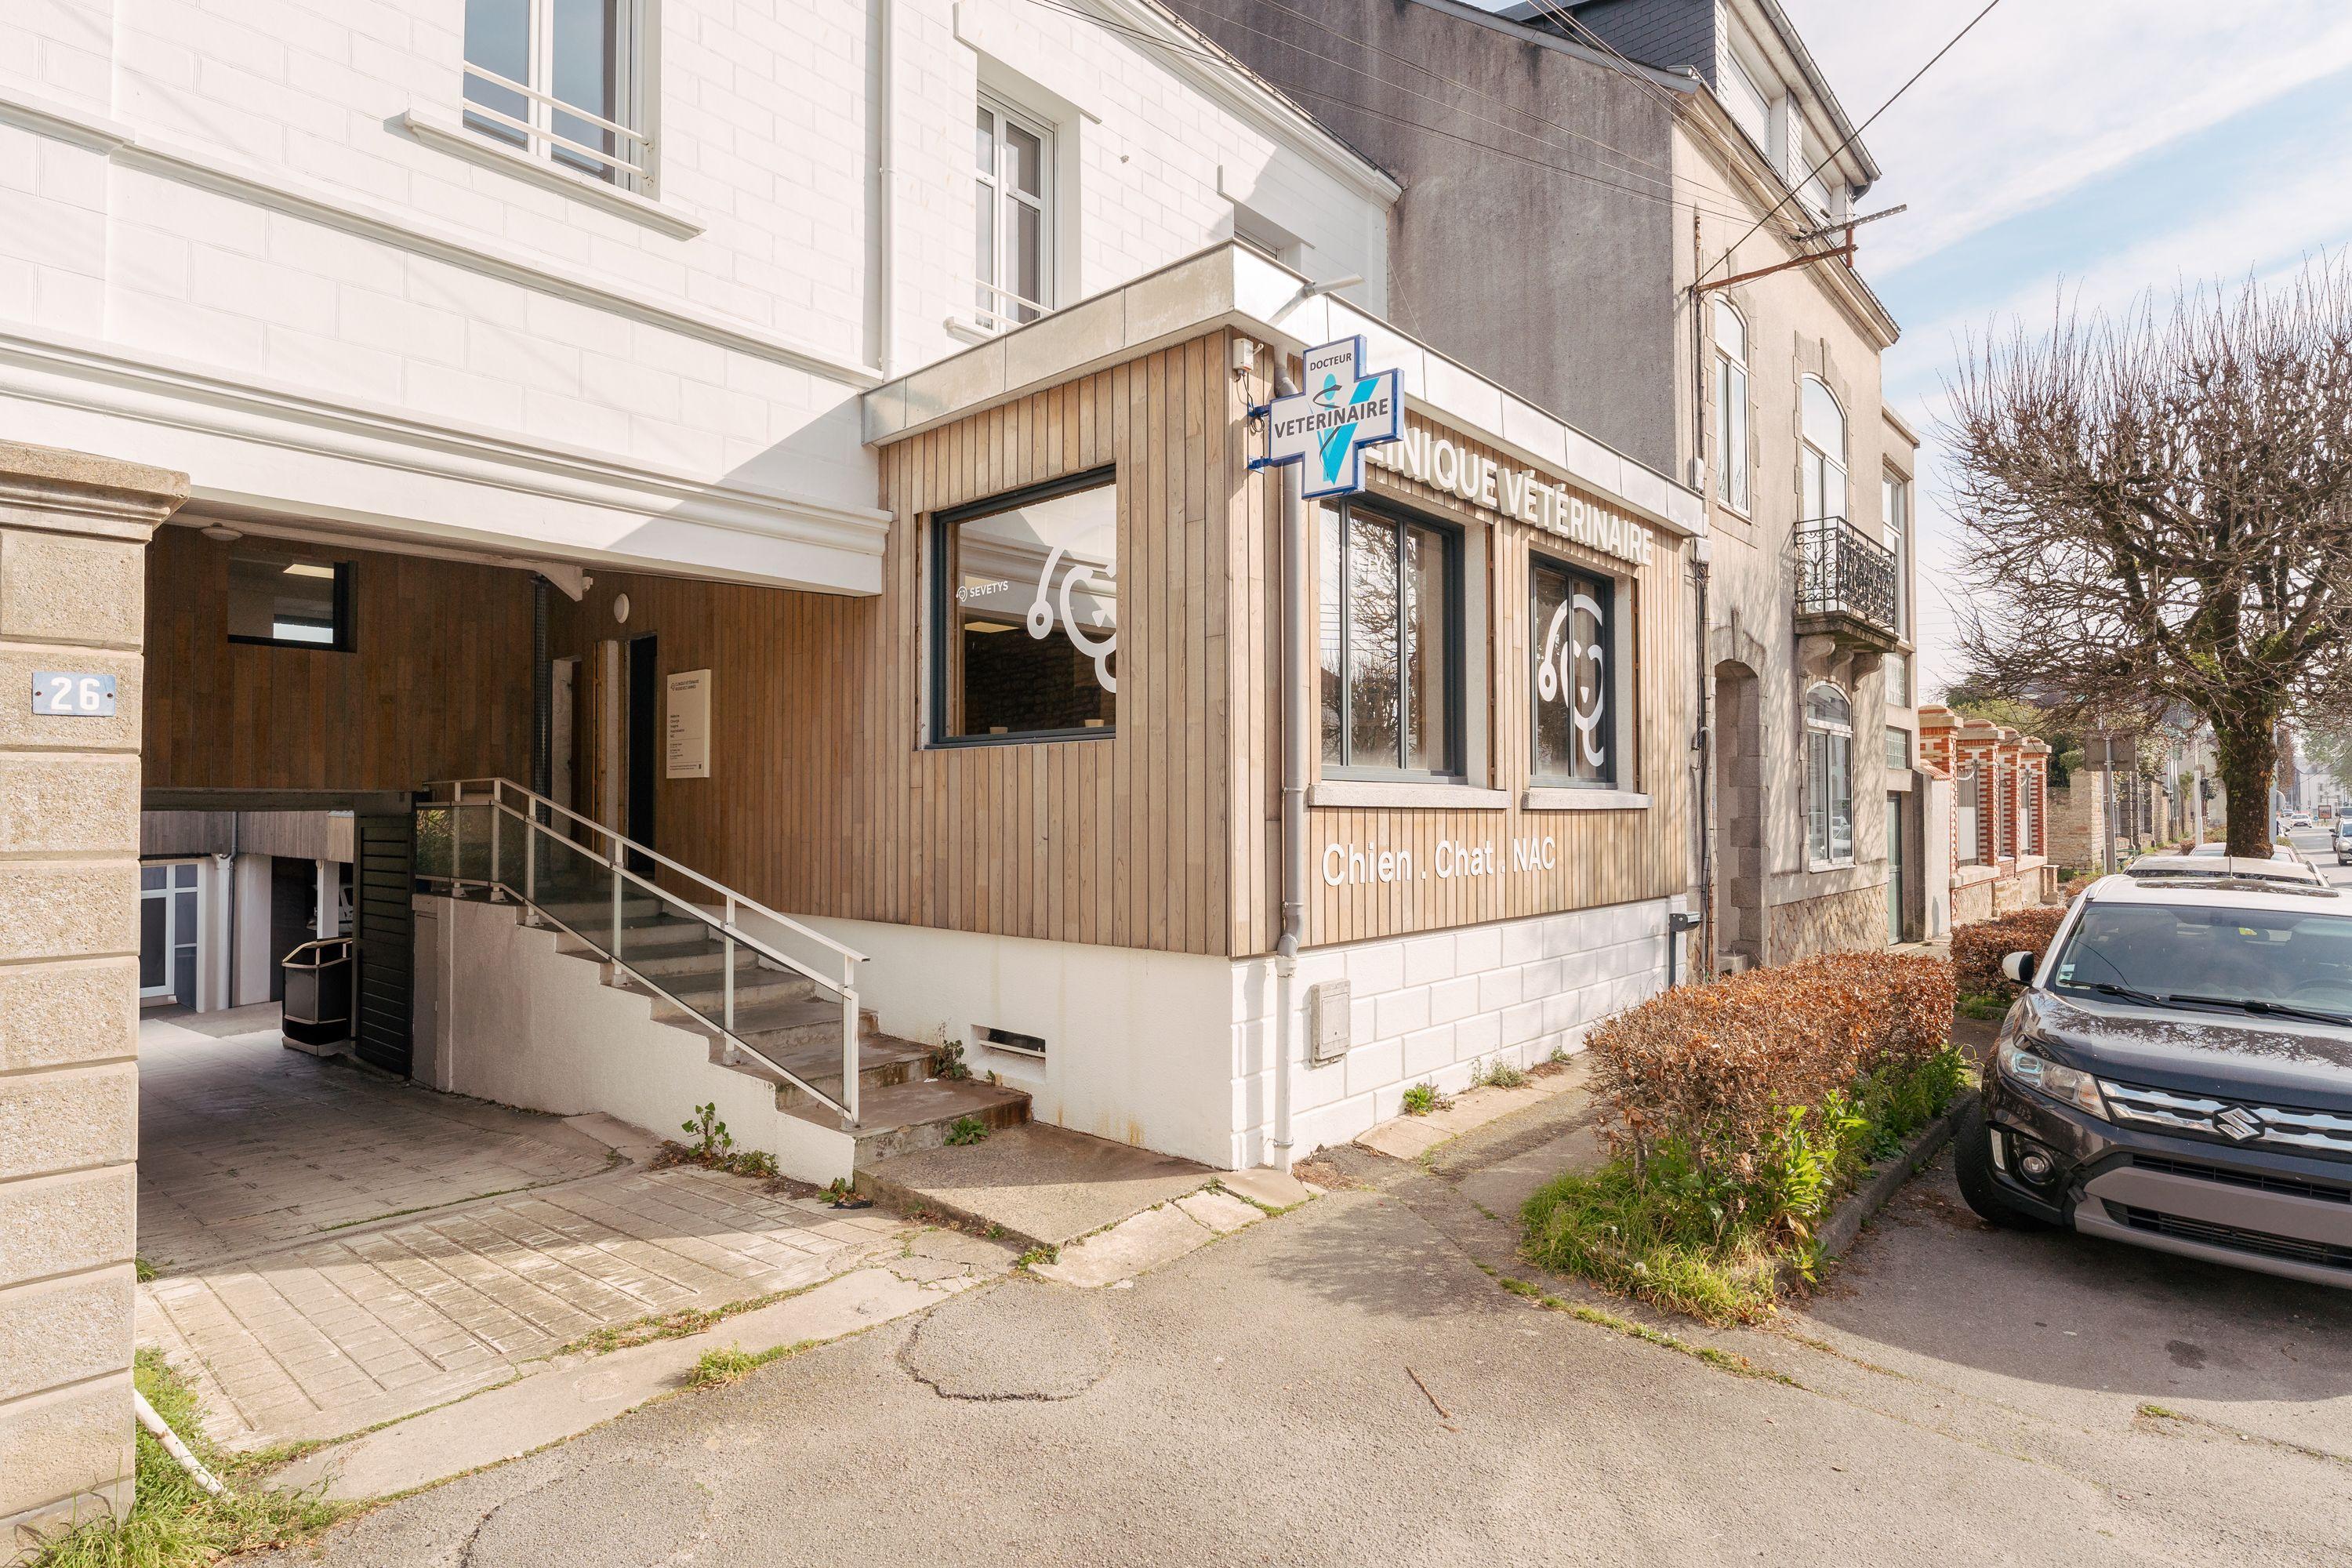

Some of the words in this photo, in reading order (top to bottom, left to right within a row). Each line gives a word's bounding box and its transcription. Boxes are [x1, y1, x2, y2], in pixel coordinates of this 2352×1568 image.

[1310, 353, 1352, 371] DOCTEUR
[1274, 397, 1388, 438] VETERINAIRE
[1502, 468, 1653, 566] VÉTÉRINAIRE
[970, 580, 1009, 597] SEVETYS
[50, 677, 100, 710] 26
[1322, 842, 1411, 887] Chien
[1434, 840, 1494, 879] Chat
[1513, 836, 1556, 873] NAC
